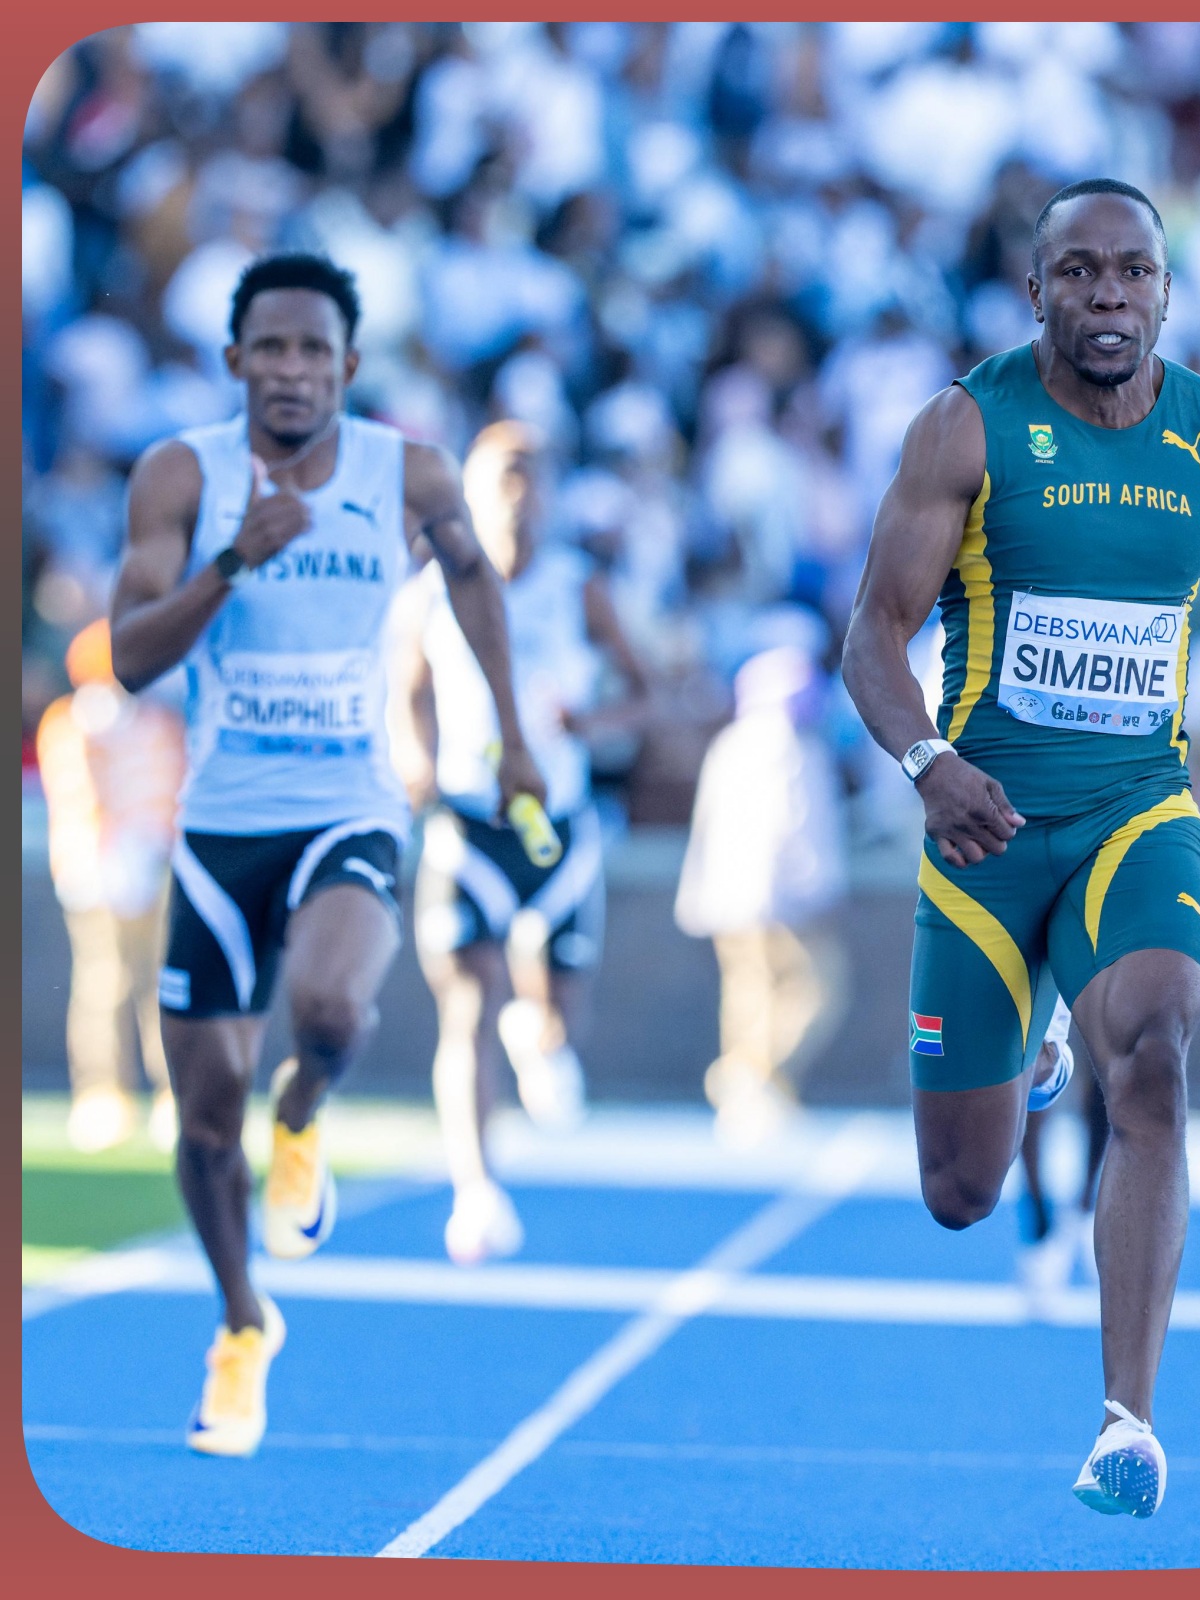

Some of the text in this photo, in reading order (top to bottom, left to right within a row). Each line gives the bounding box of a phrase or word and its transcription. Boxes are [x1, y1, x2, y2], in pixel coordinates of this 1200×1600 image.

[1042, 483, 1192, 517] SOUTH AFRICA
[1013, 611, 1152, 646] DEBSWANA
[1013, 643, 1168, 697] SIMBINE
[225, 692, 364, 727] OMPHILE
[1051, 701, 1172, 727] Gaborone 26
